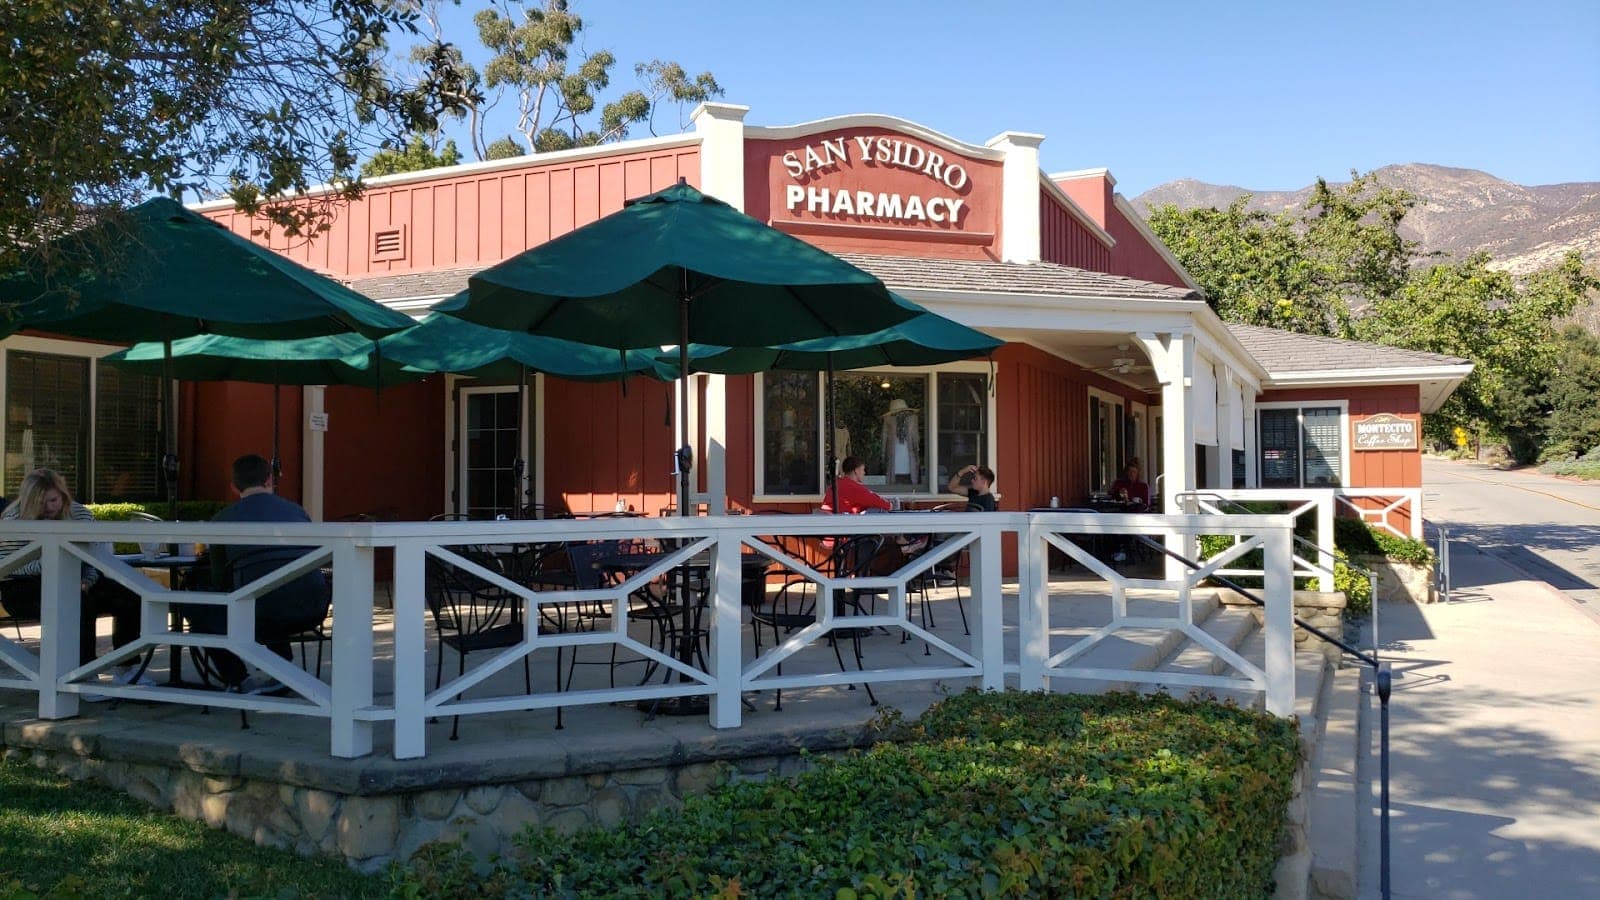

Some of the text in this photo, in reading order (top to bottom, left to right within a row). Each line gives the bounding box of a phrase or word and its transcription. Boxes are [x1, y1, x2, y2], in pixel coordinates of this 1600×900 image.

[783, 136, 967, 189] SAN YSIDRO
[786, 185, 964, 222] PHARMACY
[1357, 423, 1412, 433] MONTECITO
[1387, 434, 1412, 446] Shop
